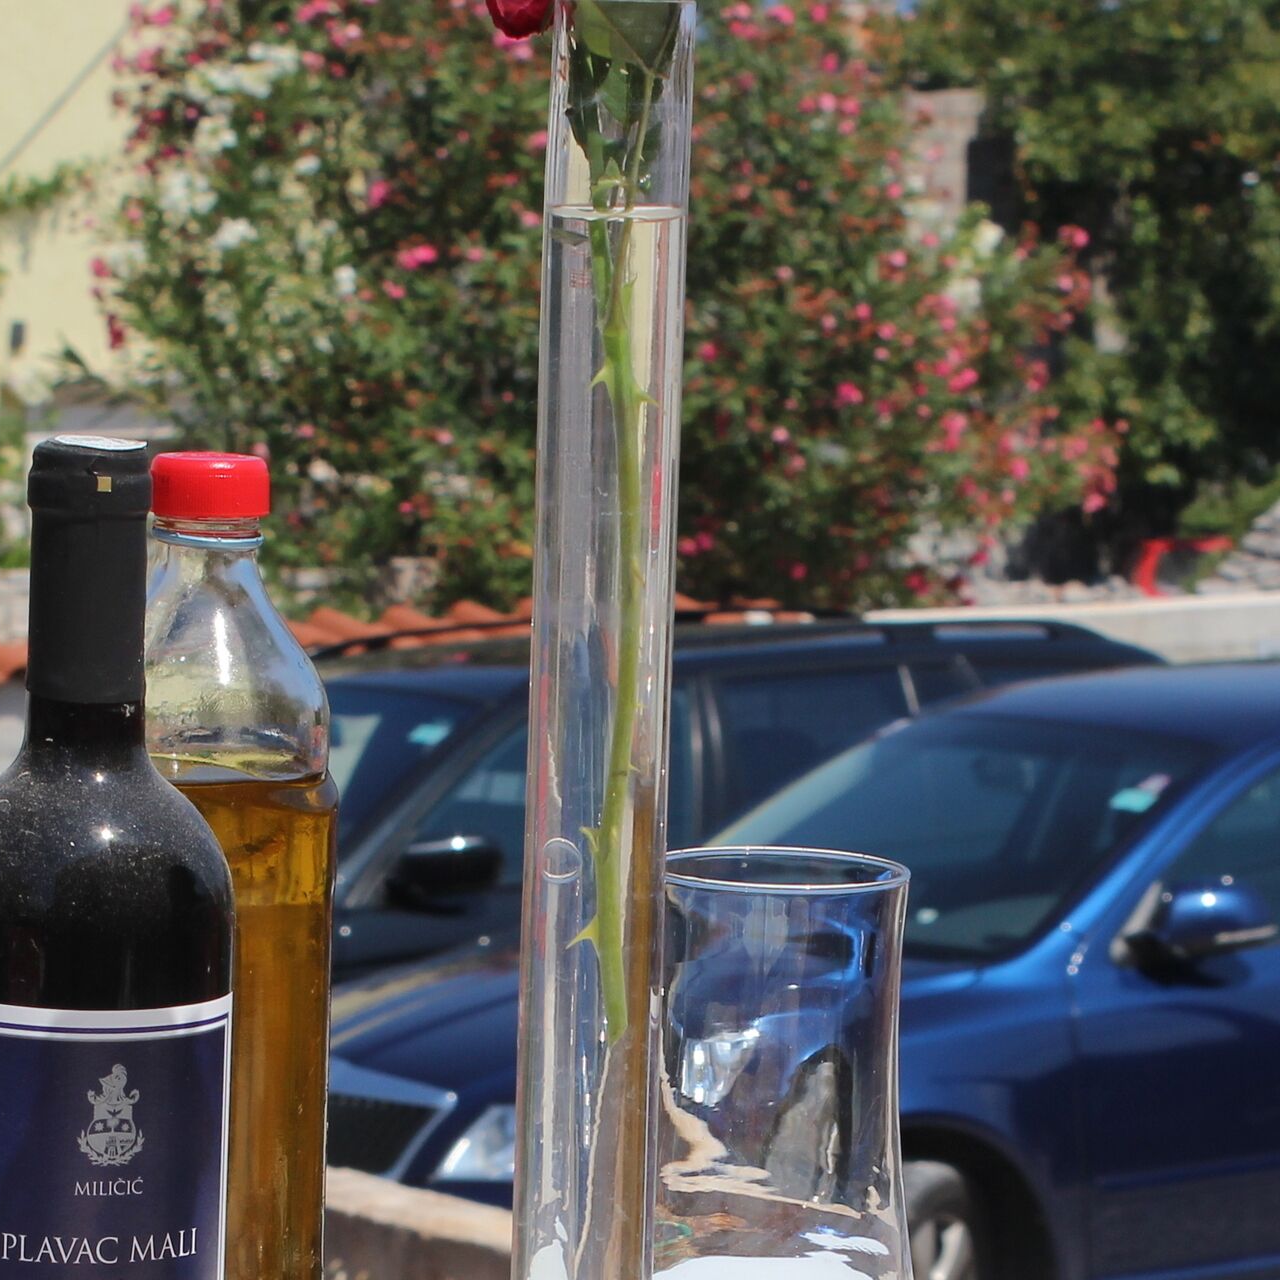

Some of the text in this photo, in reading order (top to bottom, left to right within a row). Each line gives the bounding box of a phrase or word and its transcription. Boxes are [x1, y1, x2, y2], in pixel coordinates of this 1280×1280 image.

[74, 1176, 144, 1196] MILIČIĆ
[0, 1227, 198, 1265] PLAVAC MALI
